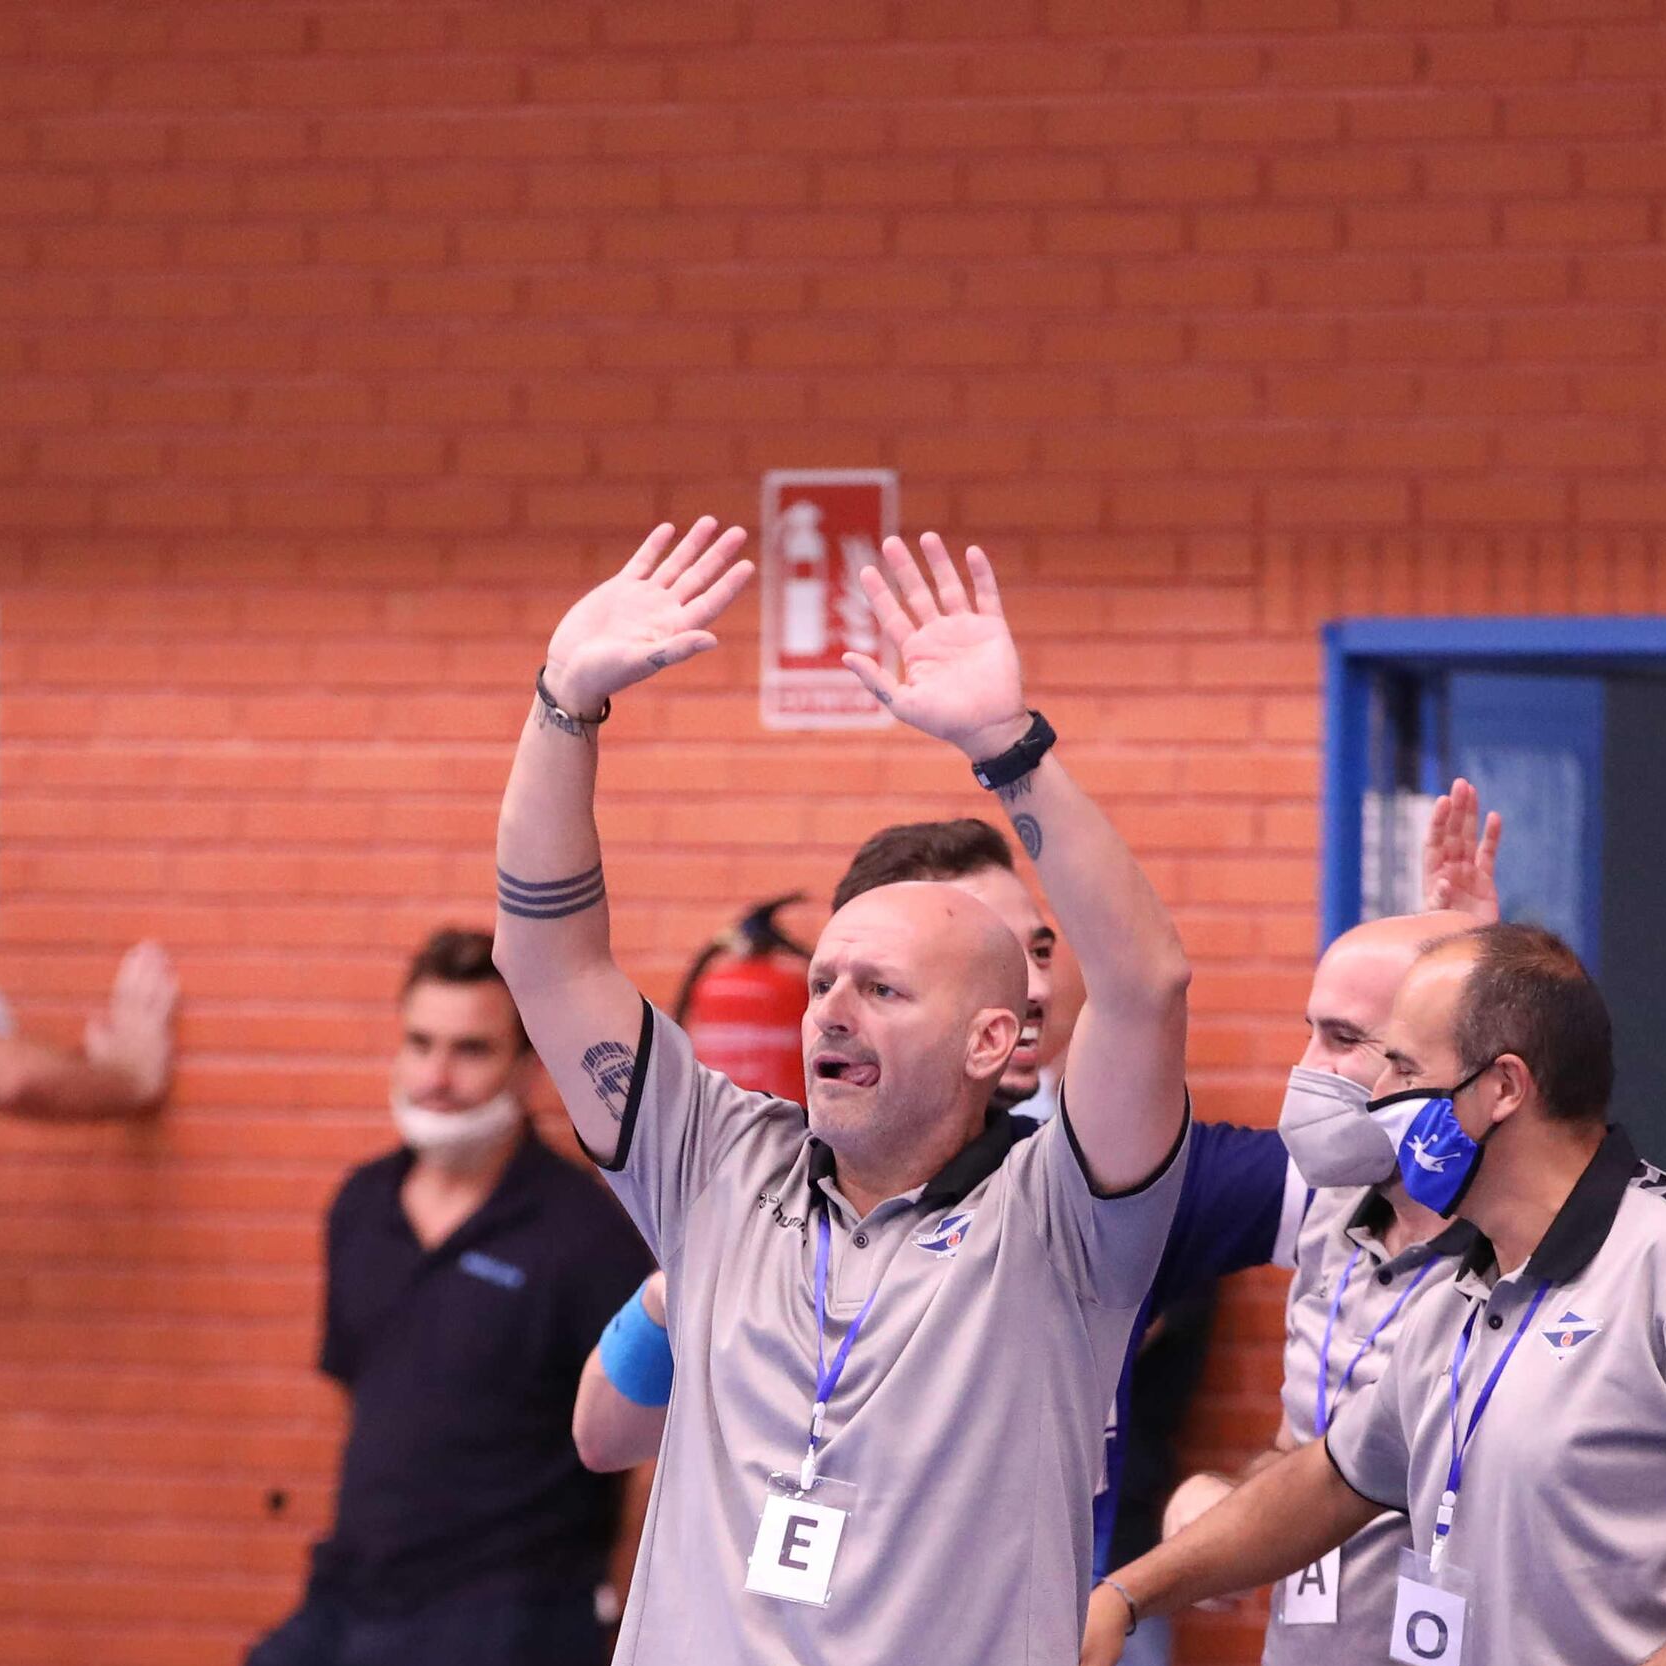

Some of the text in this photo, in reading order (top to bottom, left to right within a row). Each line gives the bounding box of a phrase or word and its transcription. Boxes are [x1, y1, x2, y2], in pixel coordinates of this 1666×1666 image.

[778, 1514, 819, 1571] E
[1296, 1560, 1327, 1596] A
[1405, 1610, 1449, 1660] O
